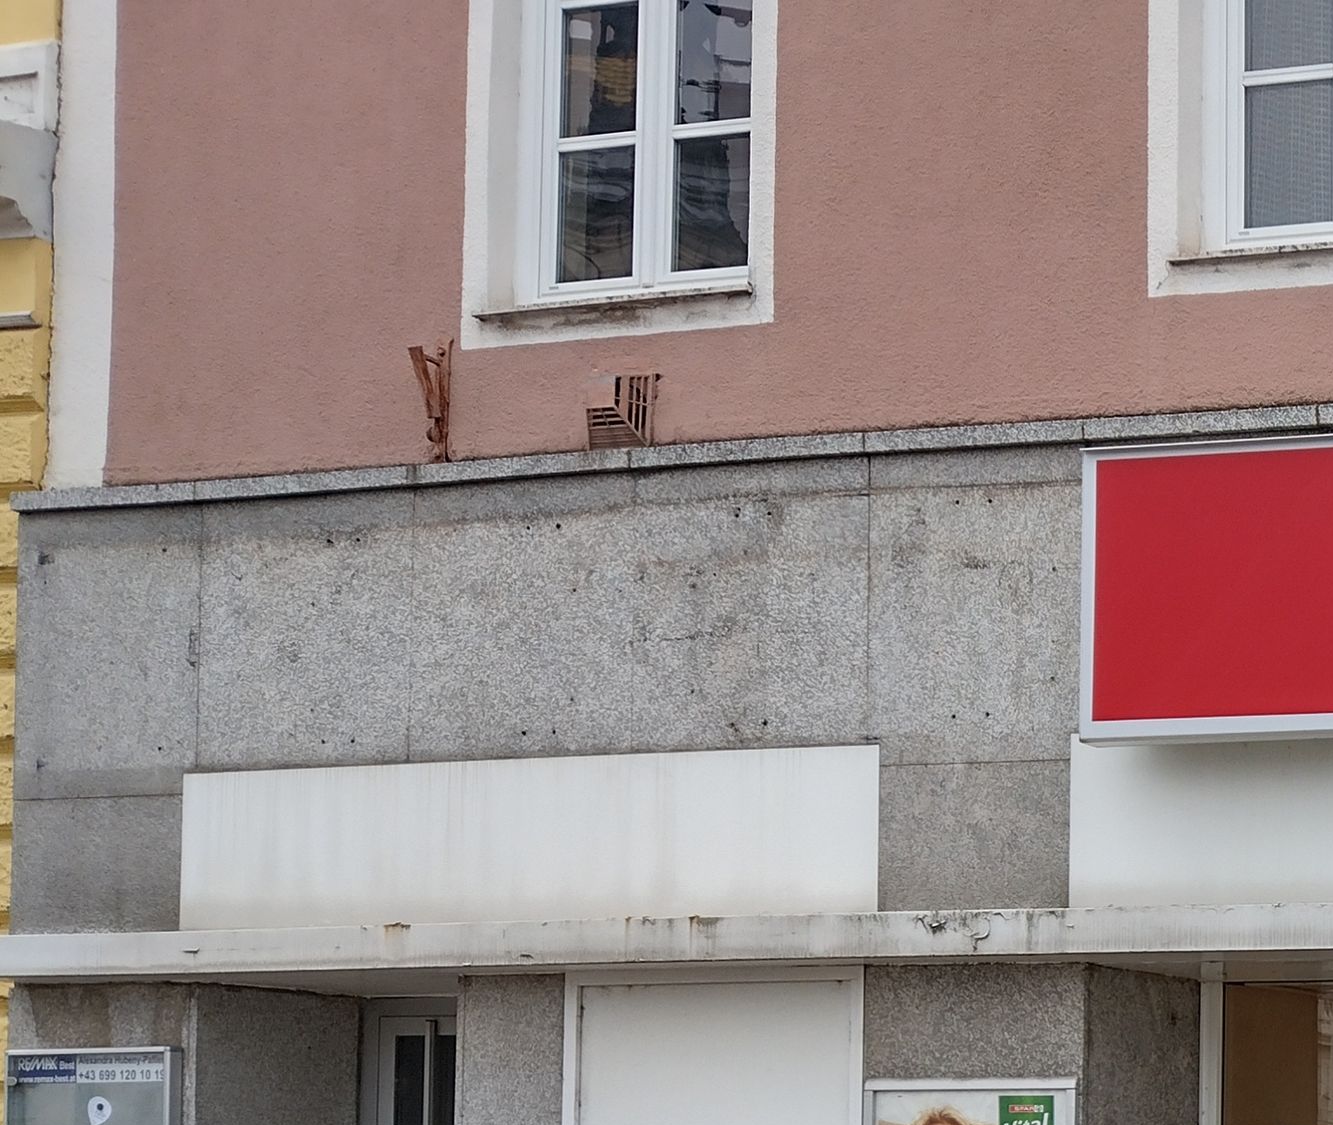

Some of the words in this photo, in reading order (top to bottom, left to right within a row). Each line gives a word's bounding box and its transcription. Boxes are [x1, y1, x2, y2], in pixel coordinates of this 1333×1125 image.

[78, 1070, 96, 1080] +43
[119, 1069, 136, 1080] 120
[140, 1069, 150, 1079] 10
